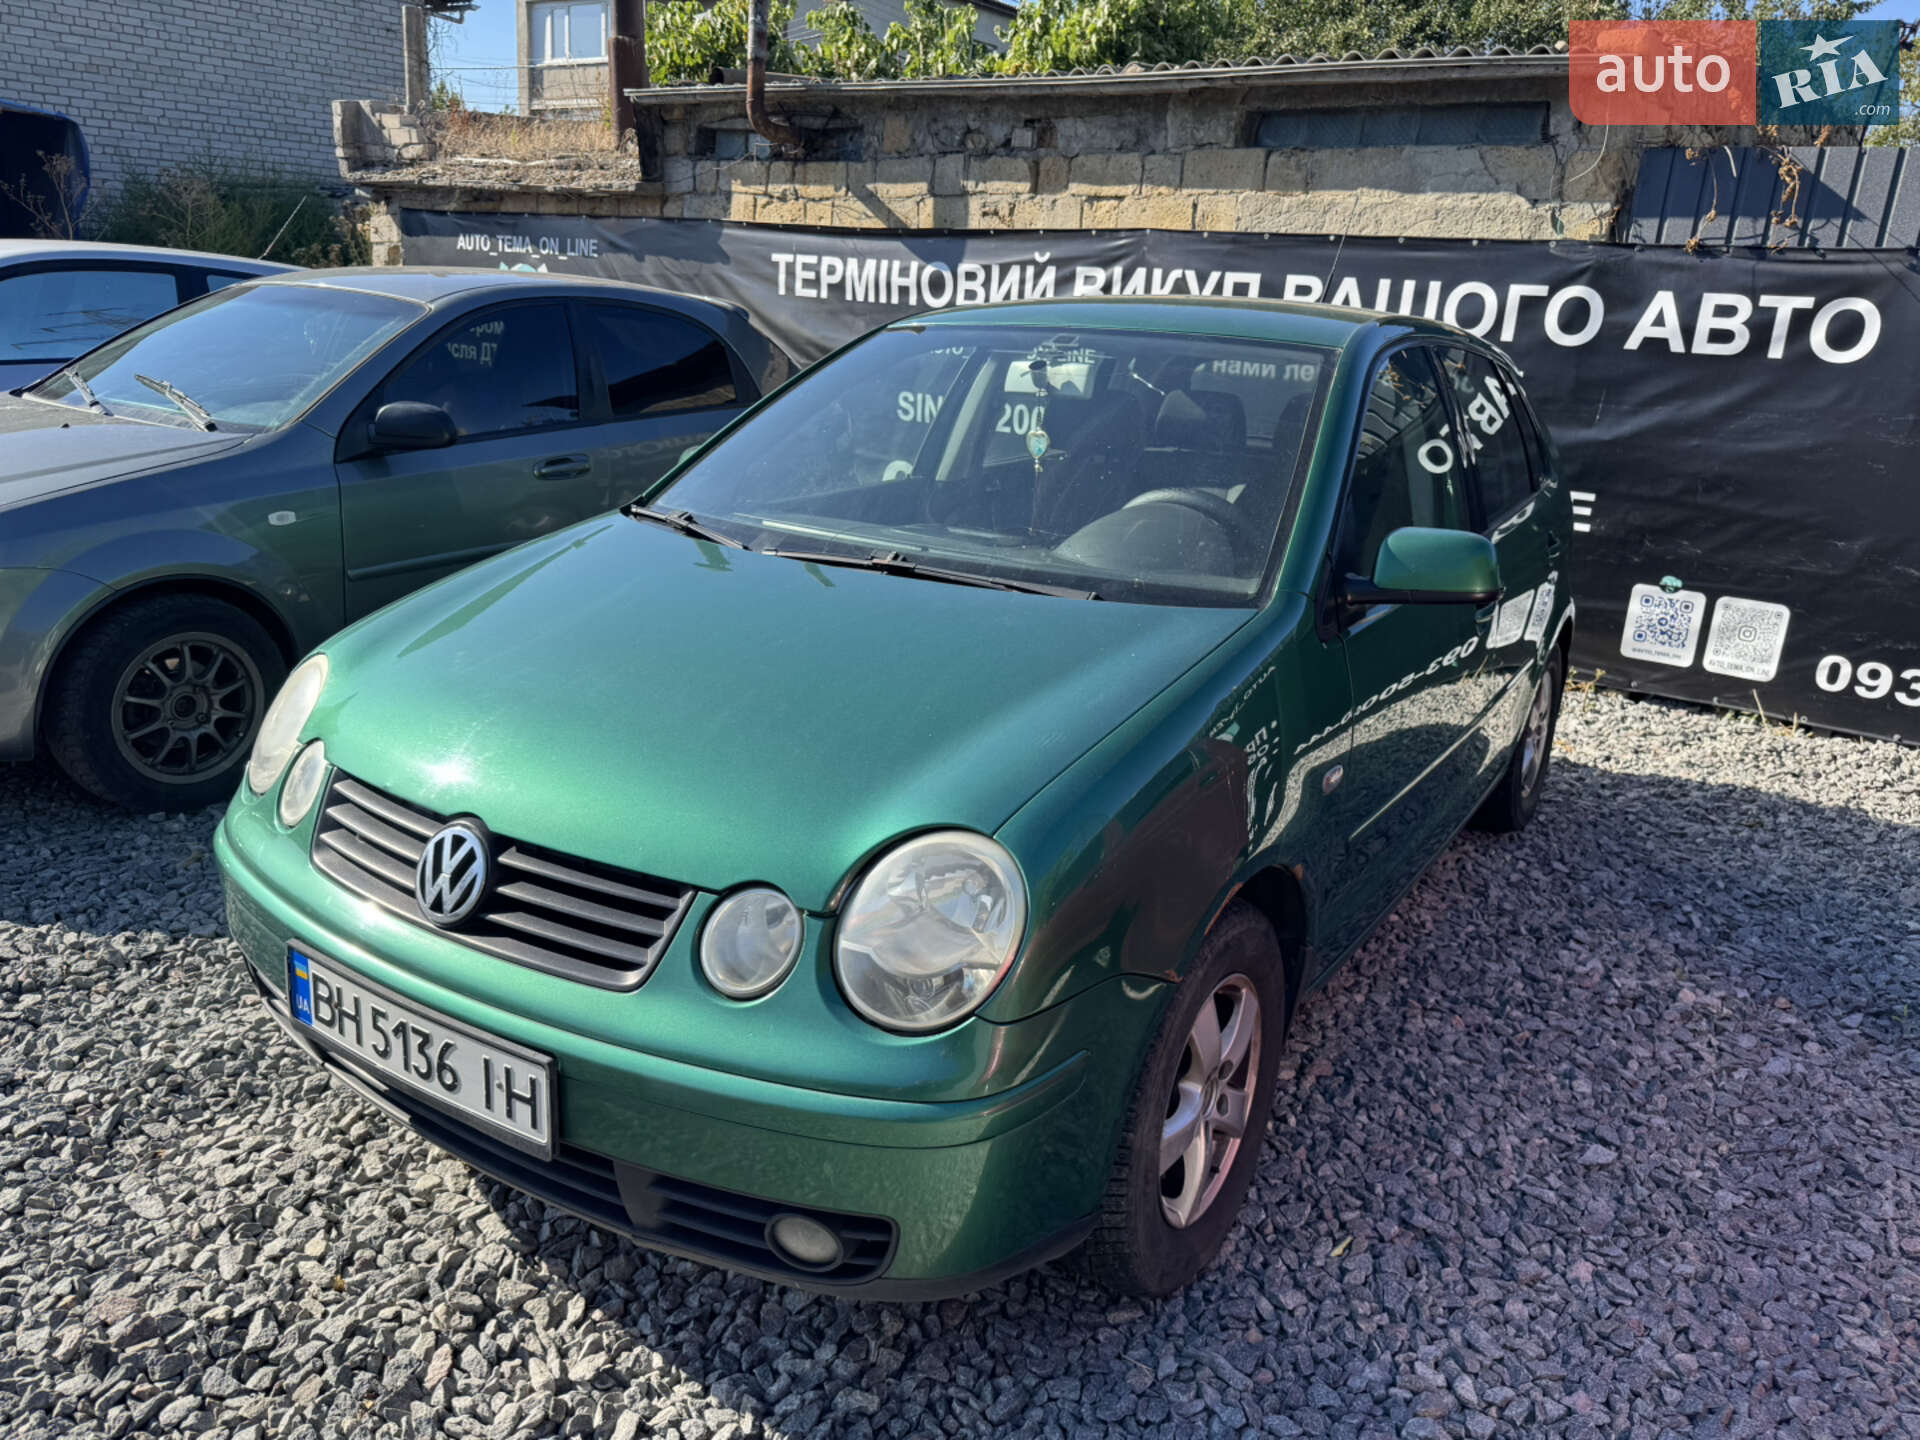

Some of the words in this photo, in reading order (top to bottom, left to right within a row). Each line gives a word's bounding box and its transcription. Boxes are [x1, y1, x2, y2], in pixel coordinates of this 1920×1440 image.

[456, 233, 599, 260] AUTO_TEMA_ON_LINE
[771, 251, 1056, 308] ТЕРМІНОВИЙ
[1623, 290, 1881, 364] АВТО
[295, 993, 310, 1015] UA
[370, 1005, 460, 1092] 5136
